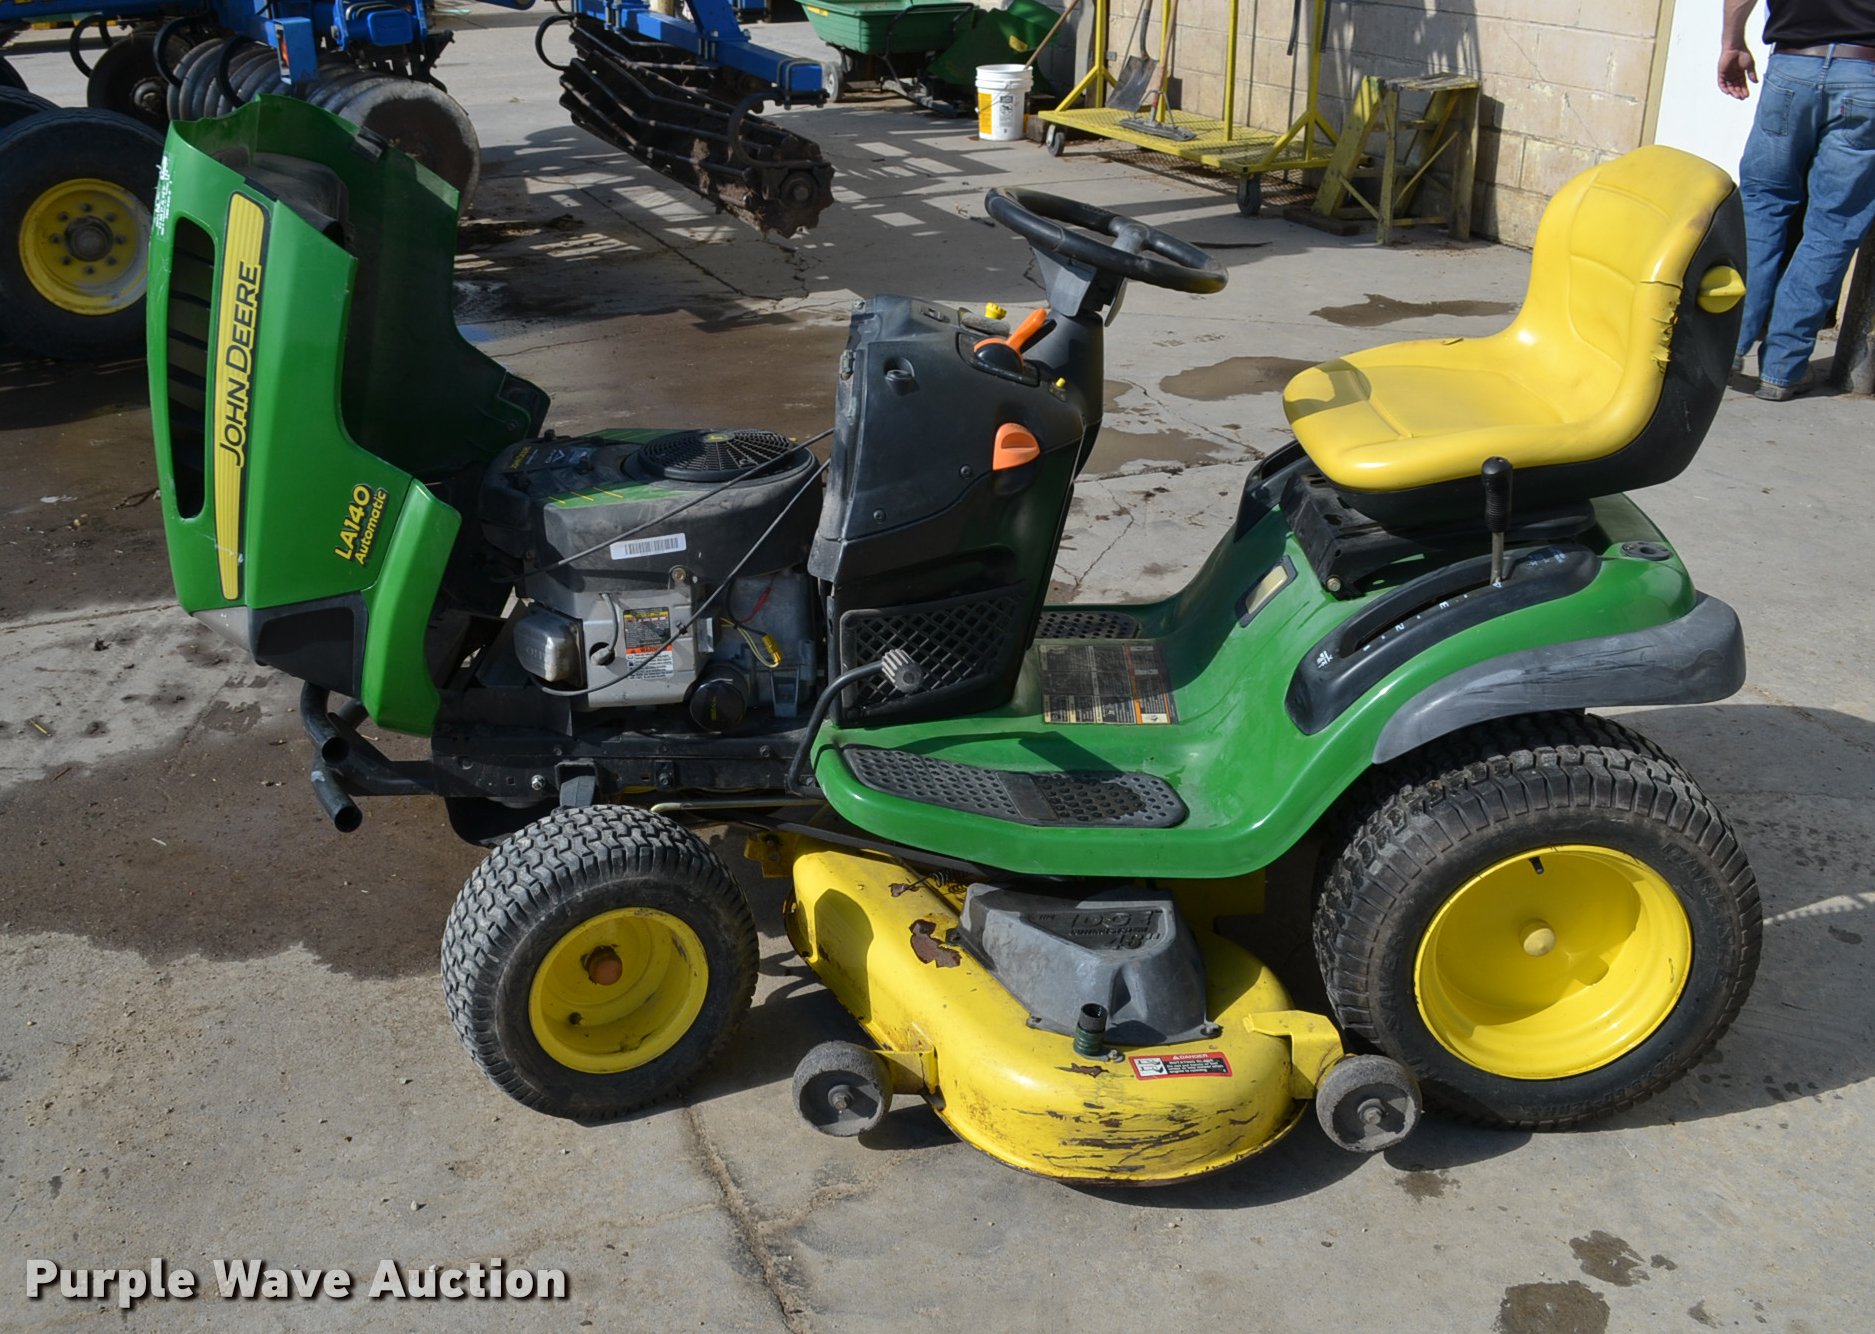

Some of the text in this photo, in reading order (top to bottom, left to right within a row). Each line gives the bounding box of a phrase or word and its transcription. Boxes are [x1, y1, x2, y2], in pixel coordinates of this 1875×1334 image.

[219, 261, 259, 467] JOHN DEERE
[334, 484, 371, 560] LA140
[354, 490, 387, 565] Automatic
